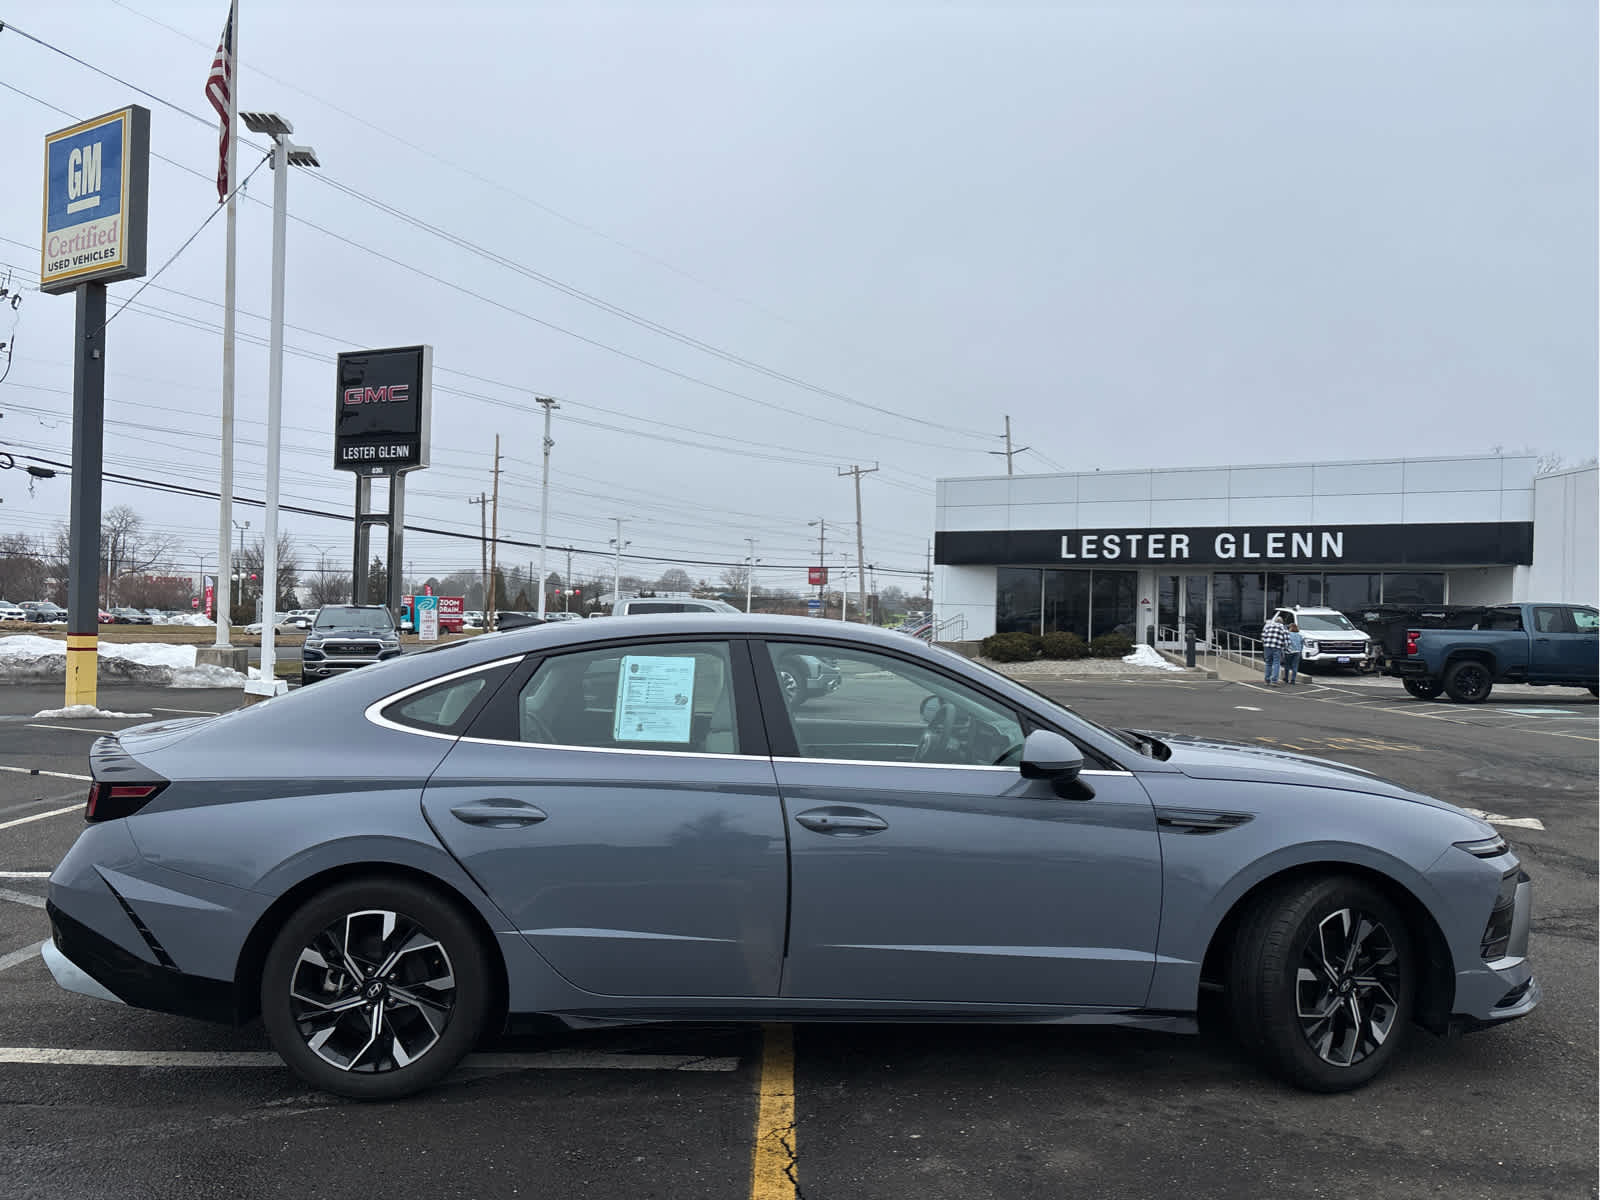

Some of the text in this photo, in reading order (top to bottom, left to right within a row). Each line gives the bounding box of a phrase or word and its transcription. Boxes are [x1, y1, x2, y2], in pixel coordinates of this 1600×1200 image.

[68, 142, 102, 200] GM
[48, 220, 118, 258] Certified
[48, 248, 116, 272] USED VEHICLES
[344, 384, 409, 404] GMC
[343, 445, 409, 459] LESTER GLENN
[1060, 532, 1344, 559] LESTER GLENN
